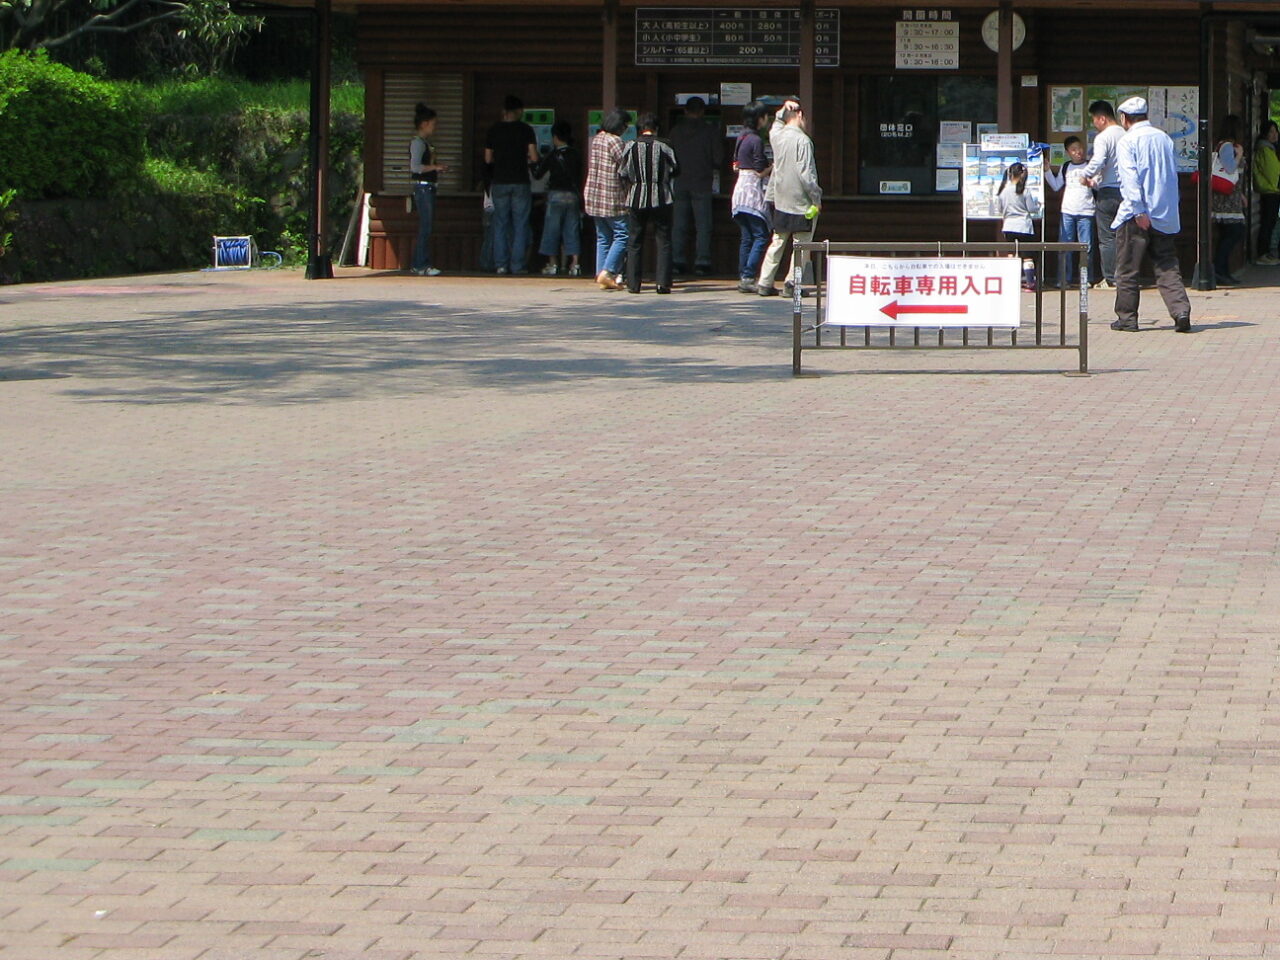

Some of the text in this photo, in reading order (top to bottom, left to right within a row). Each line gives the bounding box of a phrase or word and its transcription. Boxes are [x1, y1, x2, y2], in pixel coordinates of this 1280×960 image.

[879, 123, 913, 131] 団体窓口
[849, 274, 1003, 296] 自転車専用入口
